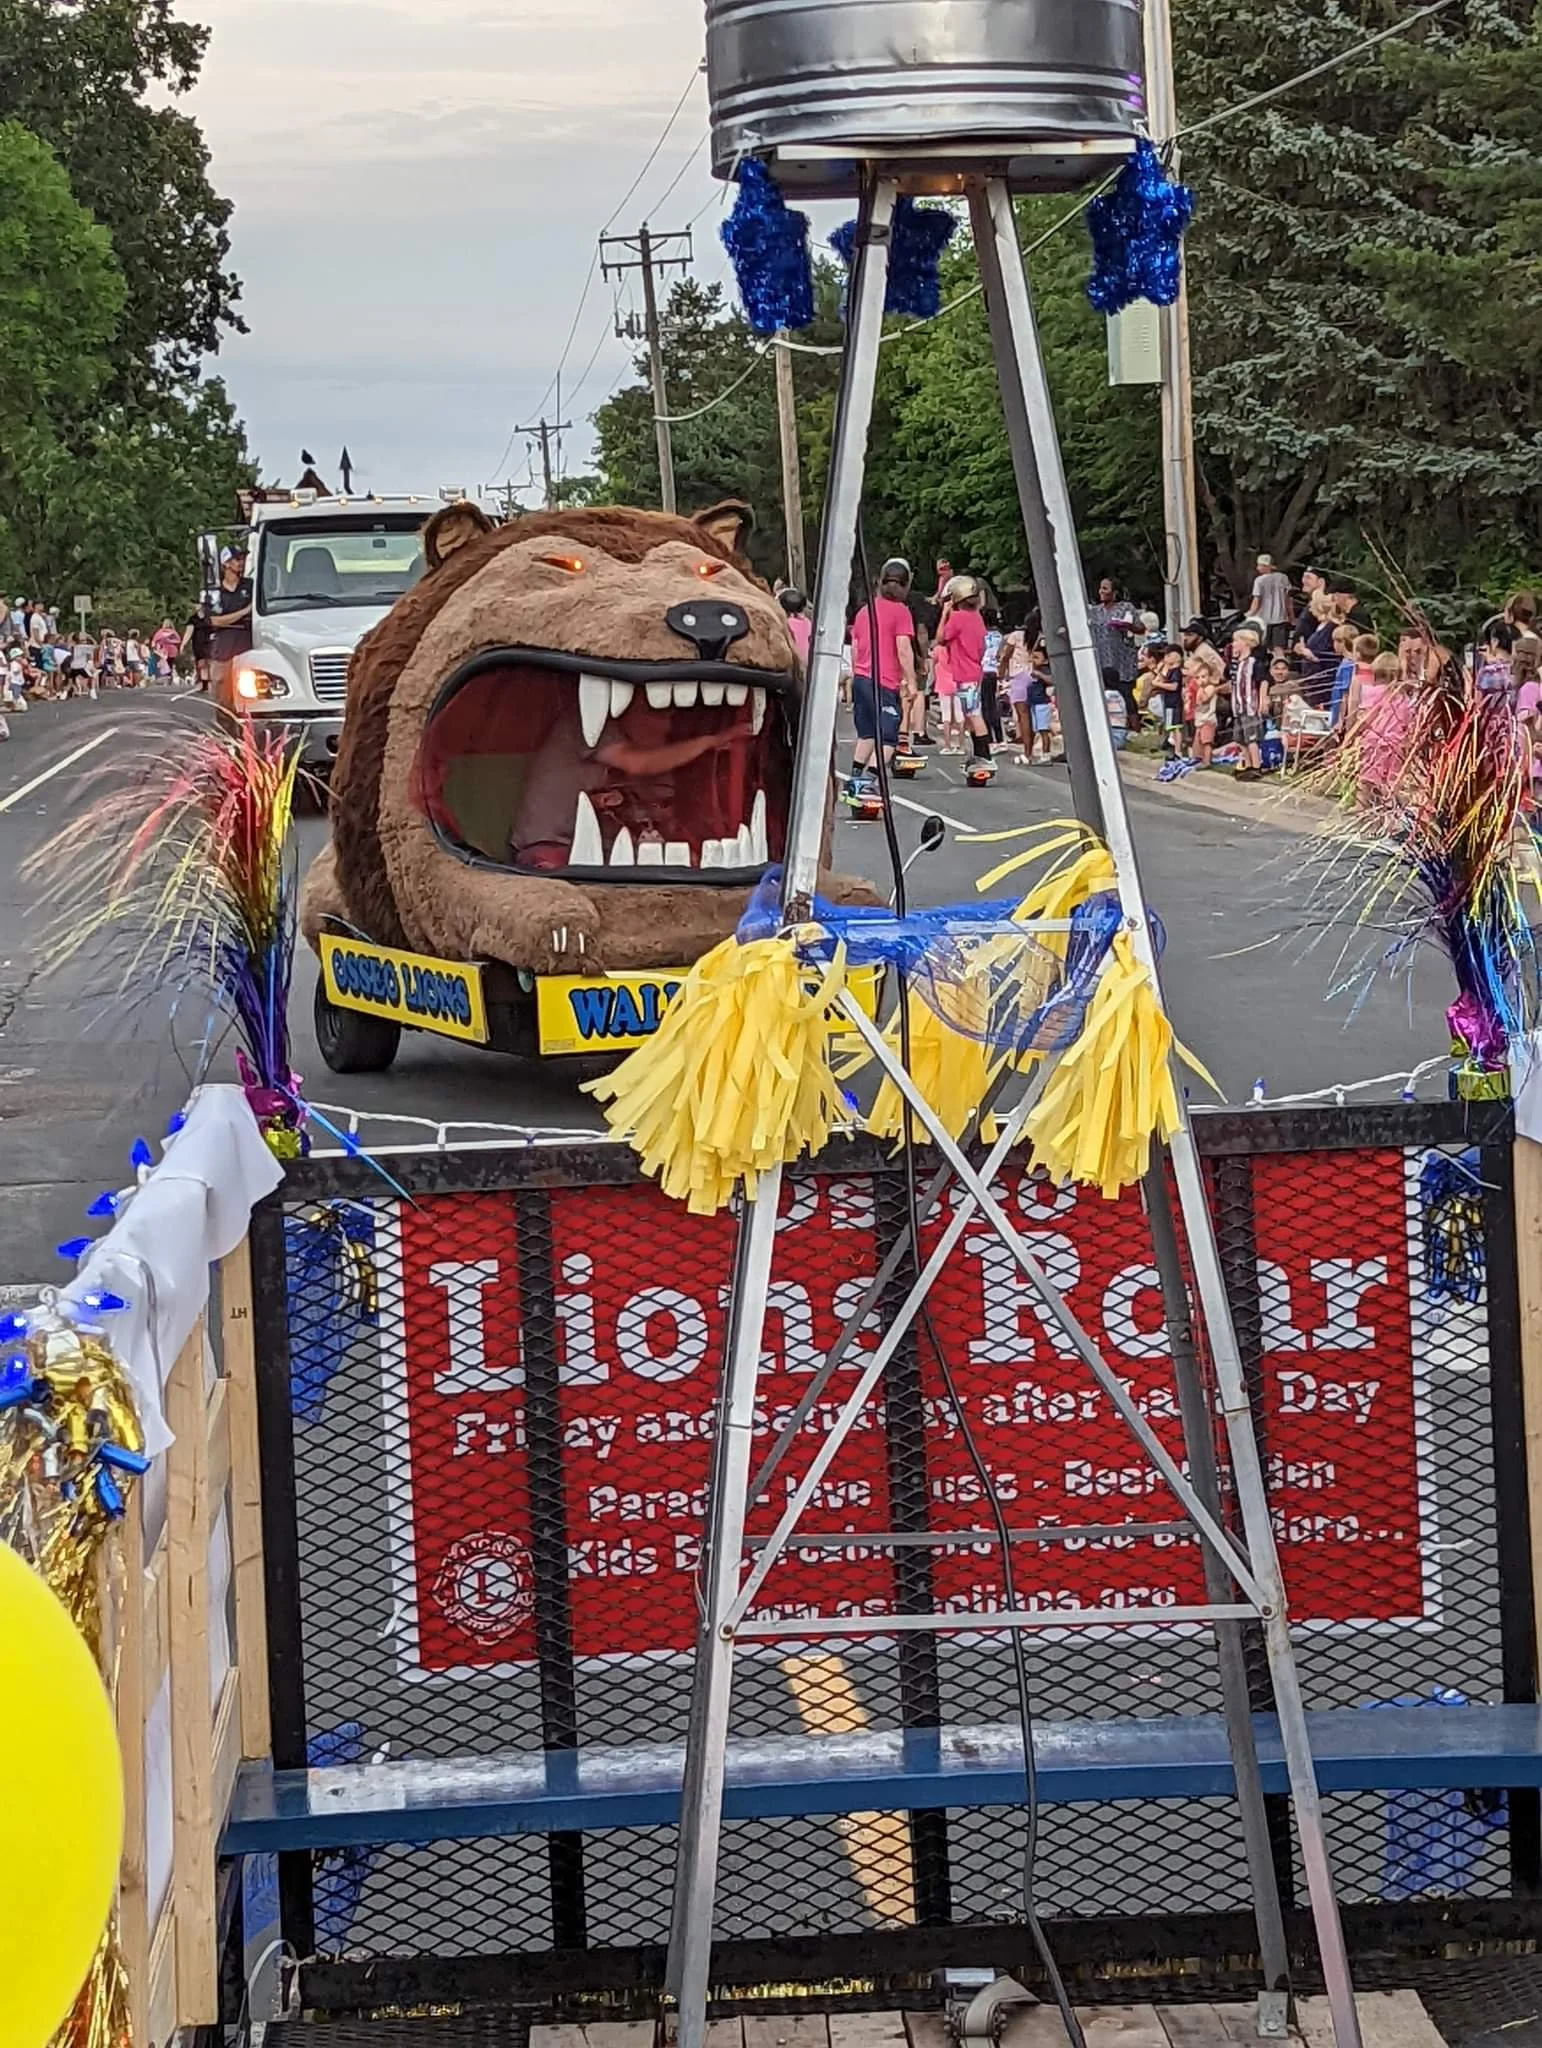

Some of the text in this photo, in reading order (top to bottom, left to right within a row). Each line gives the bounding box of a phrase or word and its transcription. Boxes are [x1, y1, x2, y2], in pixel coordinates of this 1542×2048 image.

[332, 947, 472, 1027] OSSEO LIONS
[569, 981, 683, 1040] WAL
[453, 1409, 621, 1459] Friay
[982, 1381, 1100, 1424] after
[1276, 1371, 1381, 1424] Day
[588, 1482, 711, 1523] Parad
[931, 1464, 1018, 1502] usic
[567, 1536, 659, 1579] Kids
